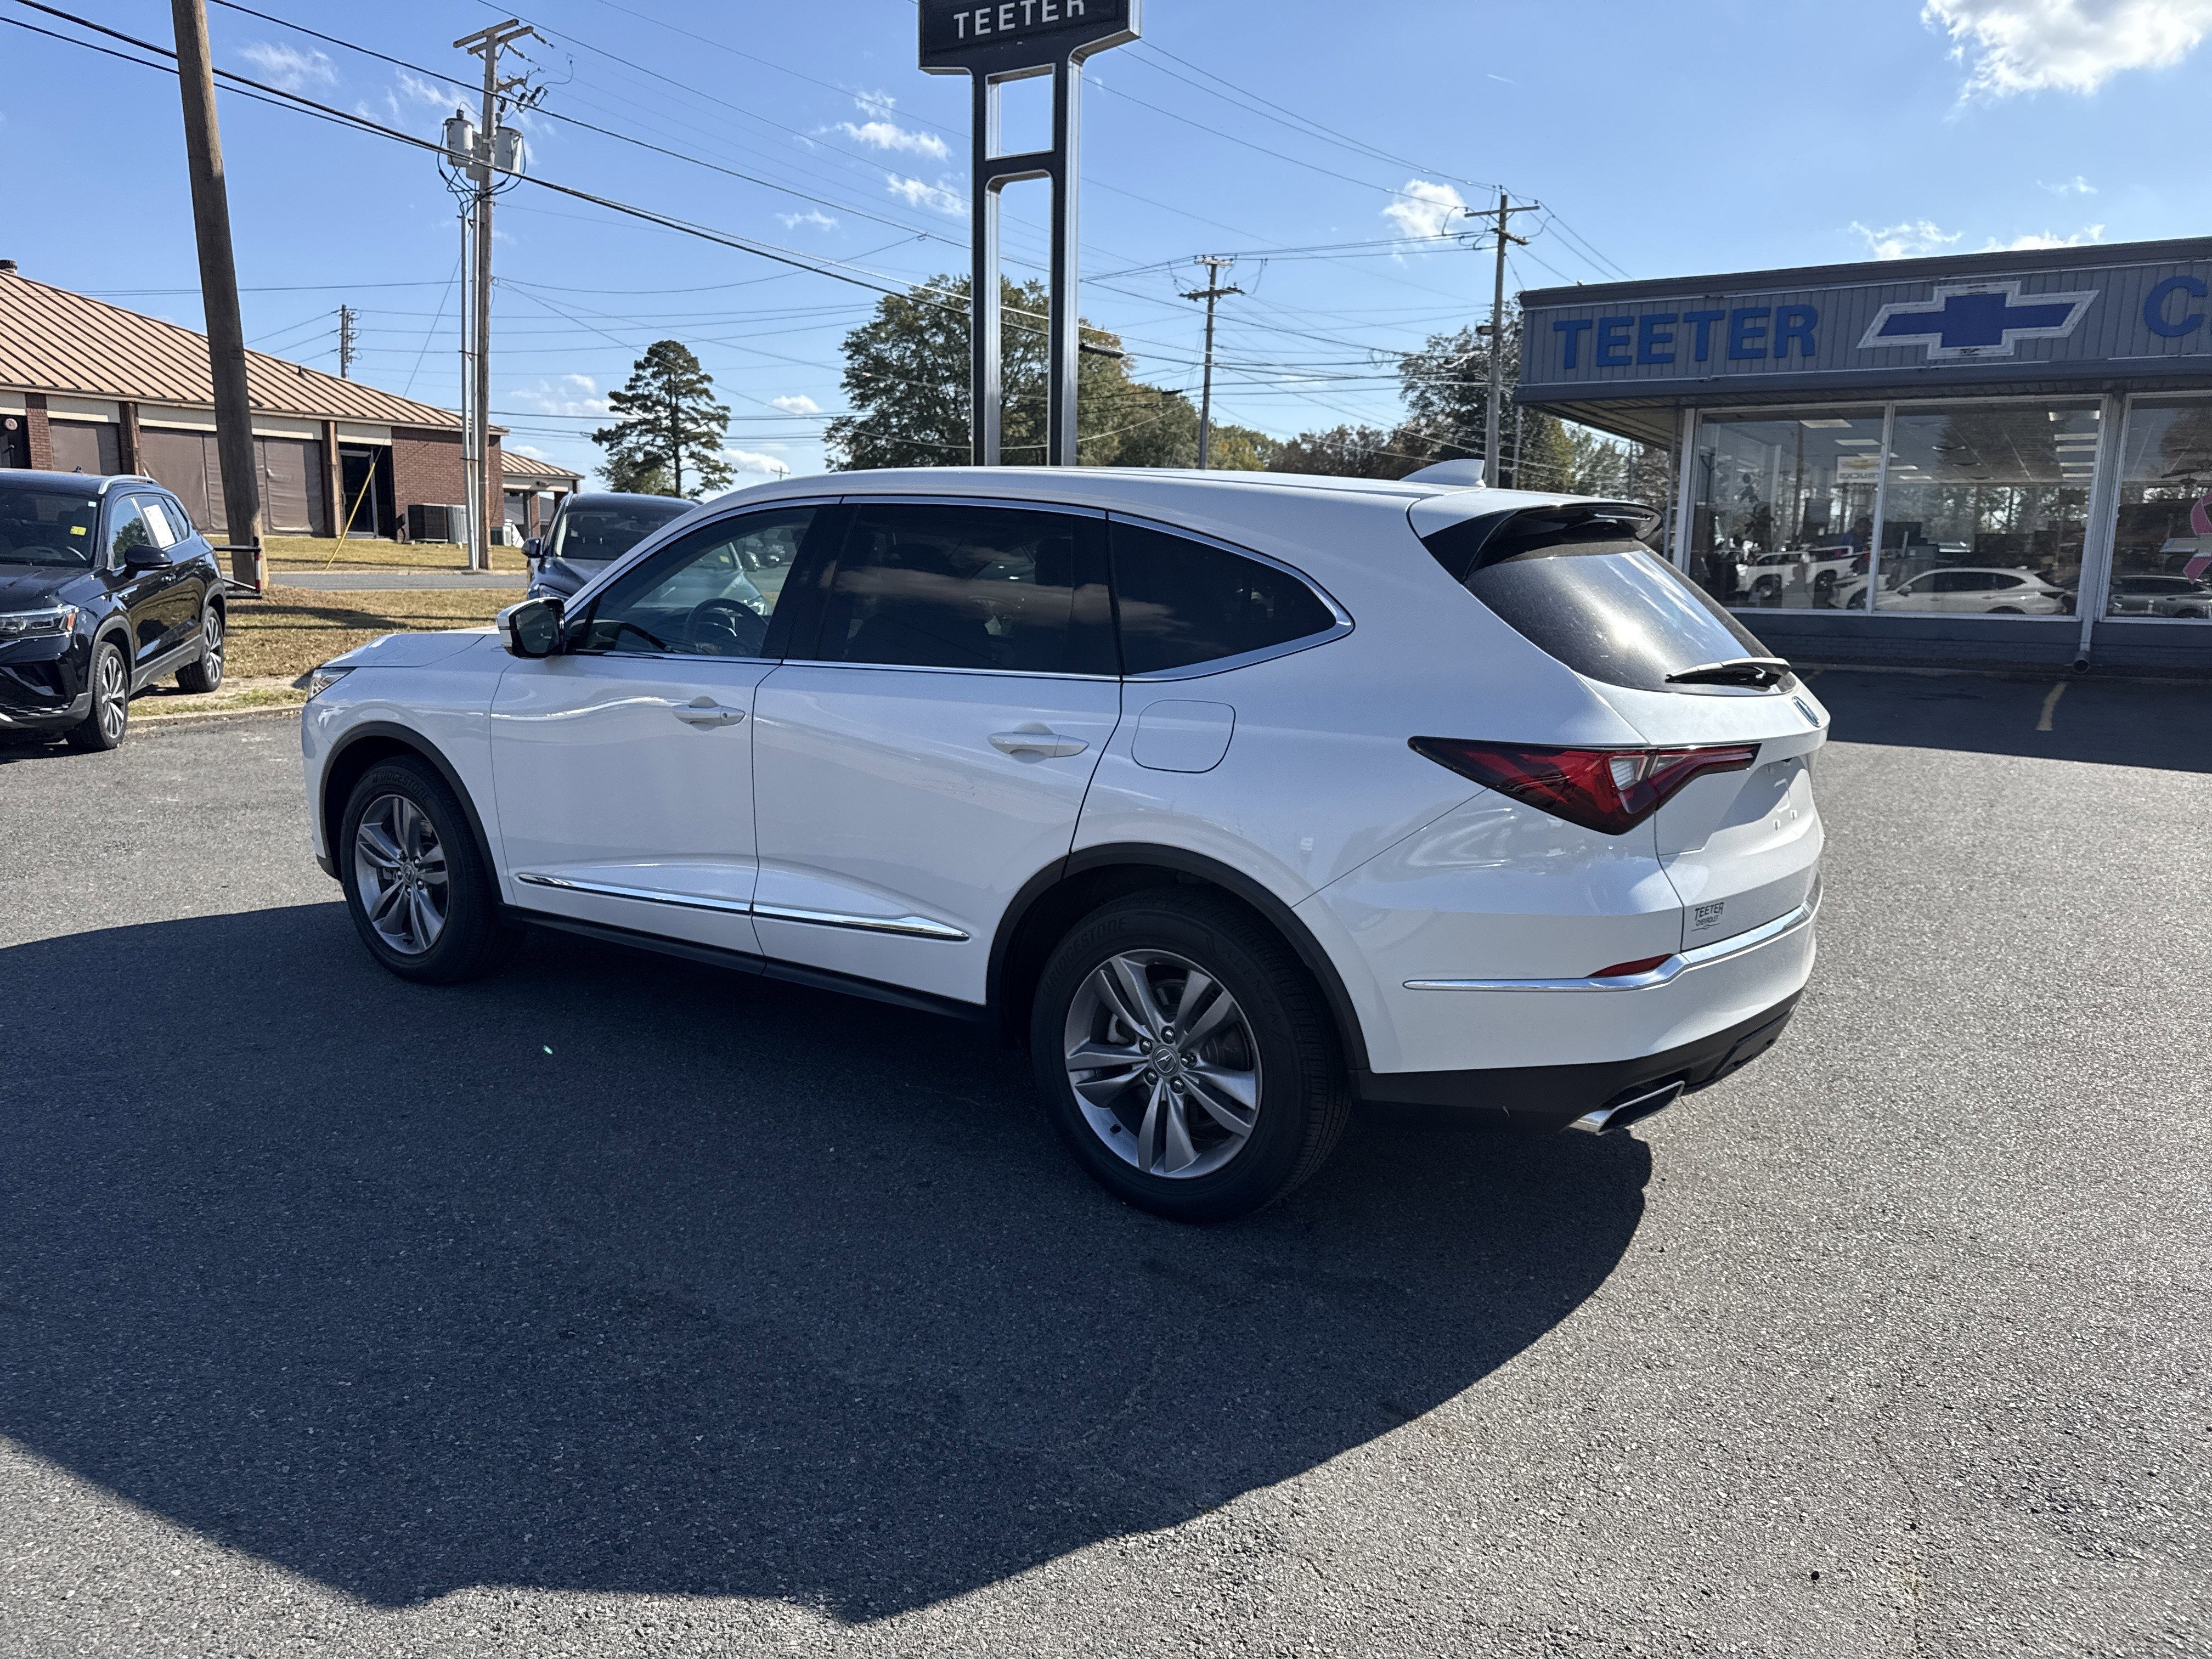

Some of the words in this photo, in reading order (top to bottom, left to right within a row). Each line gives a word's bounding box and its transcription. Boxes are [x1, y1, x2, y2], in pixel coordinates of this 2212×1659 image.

[953, 0, 1085, 39] TEETER
[1553, 305, 1819, 369] TEETER
[372, 770, 431, 803] BRIDGESTONE
[1695, 902, 1724, 921] TEETER
